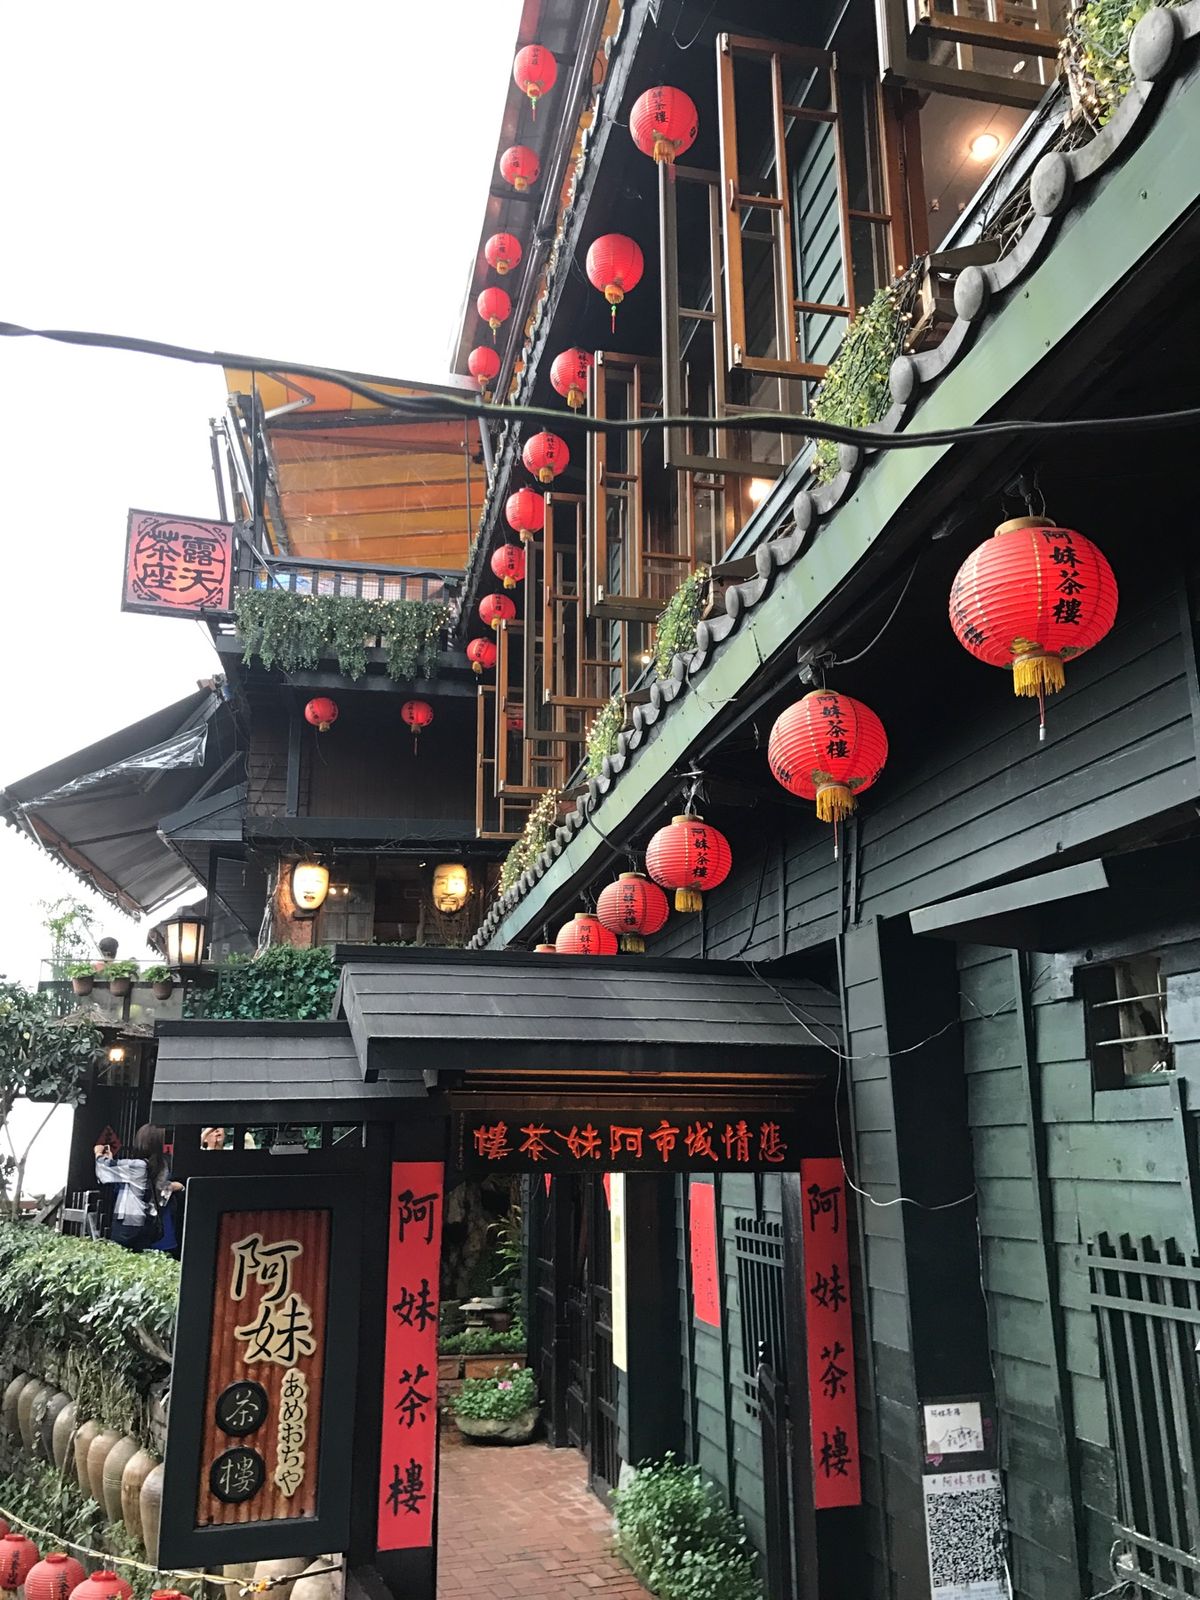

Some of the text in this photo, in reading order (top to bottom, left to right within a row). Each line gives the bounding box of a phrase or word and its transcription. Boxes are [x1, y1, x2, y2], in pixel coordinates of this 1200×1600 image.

[1042, 529, 1087, 625] 阿妹茶樓
[690, 828, 711, 878] 阿妹茶樓
[233, 1235, 314, 1365] 阿妹
[384, 1188, 440, 1517] 阿妹茶樓
[806, 1183, 853, 1479] 阿妹茶樓
[219, 1390, 259, 1494] 茶樓
